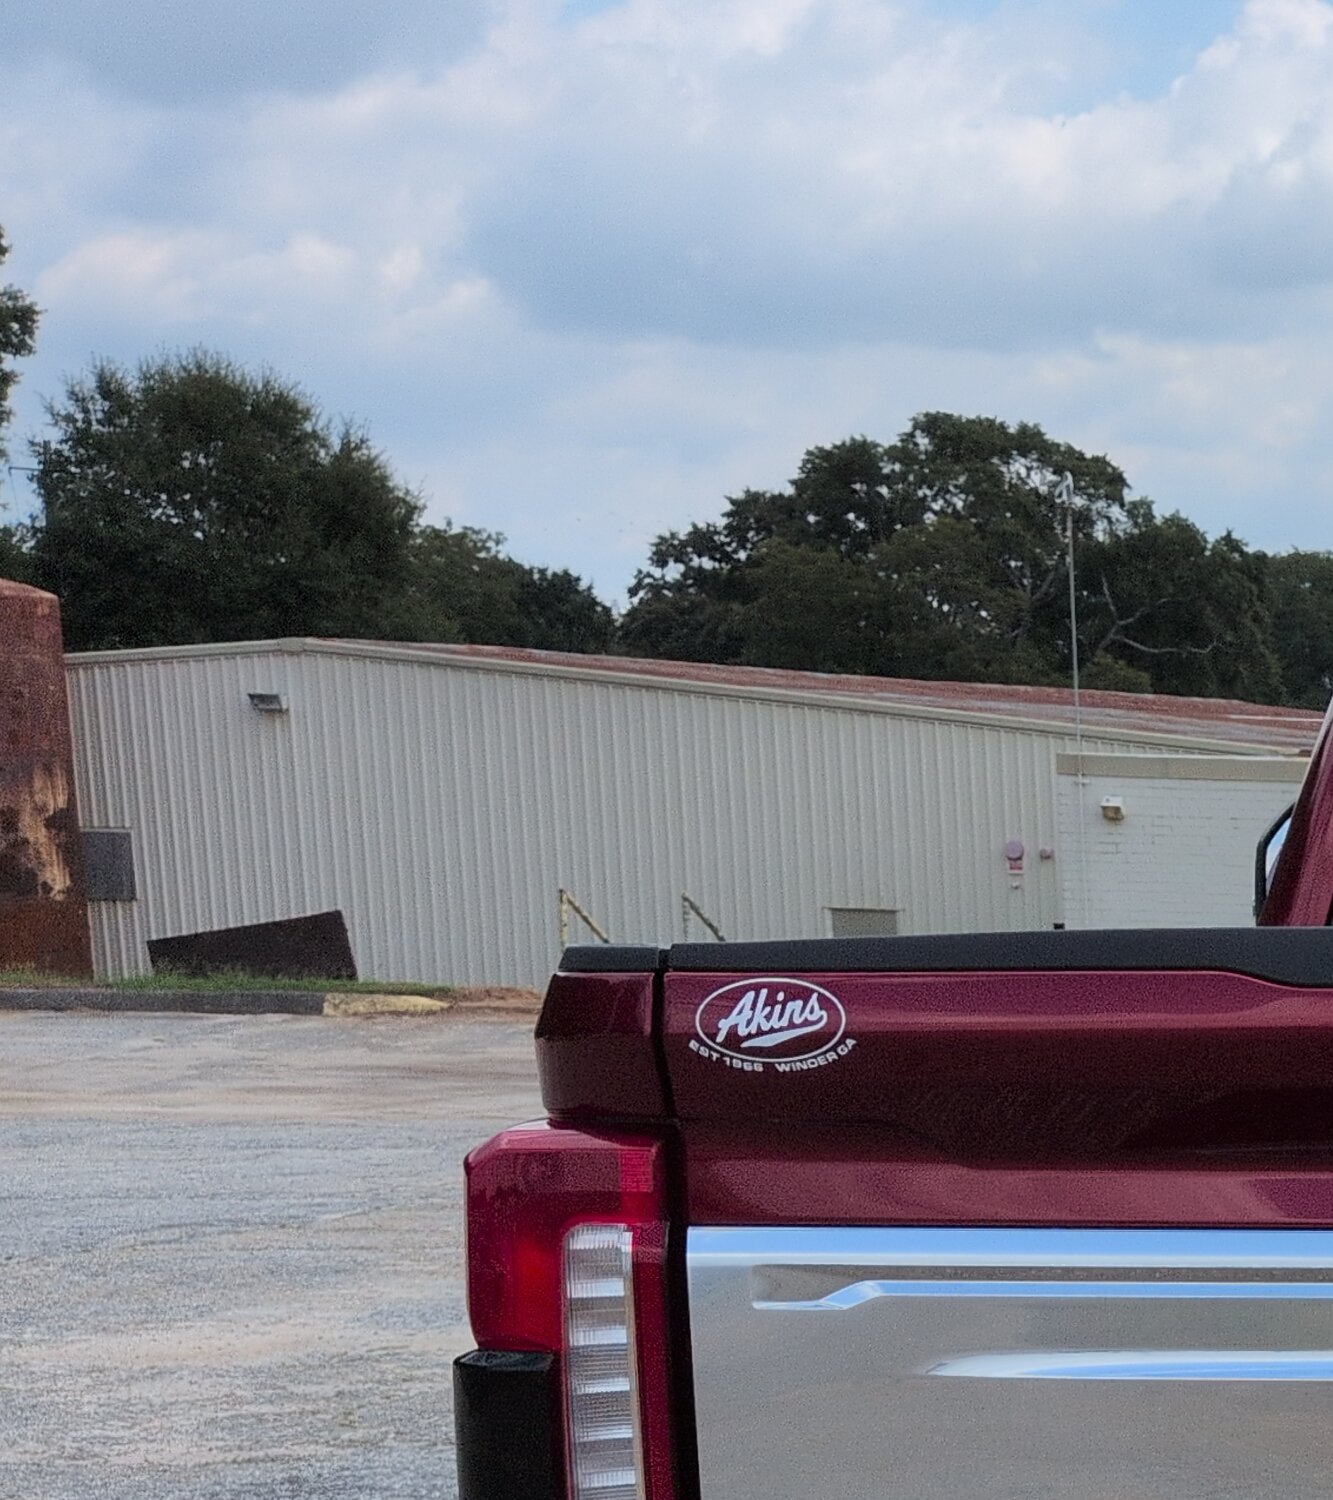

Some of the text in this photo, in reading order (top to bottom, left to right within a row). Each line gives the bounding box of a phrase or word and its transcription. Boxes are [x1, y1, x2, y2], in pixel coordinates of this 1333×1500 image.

[715, 988, 828, 1047] Akins
[688, 1040, 720, 1062] EST
[774, 1051, 839, 1072] WINDER
[836, 1038, 857, 1056] GA
